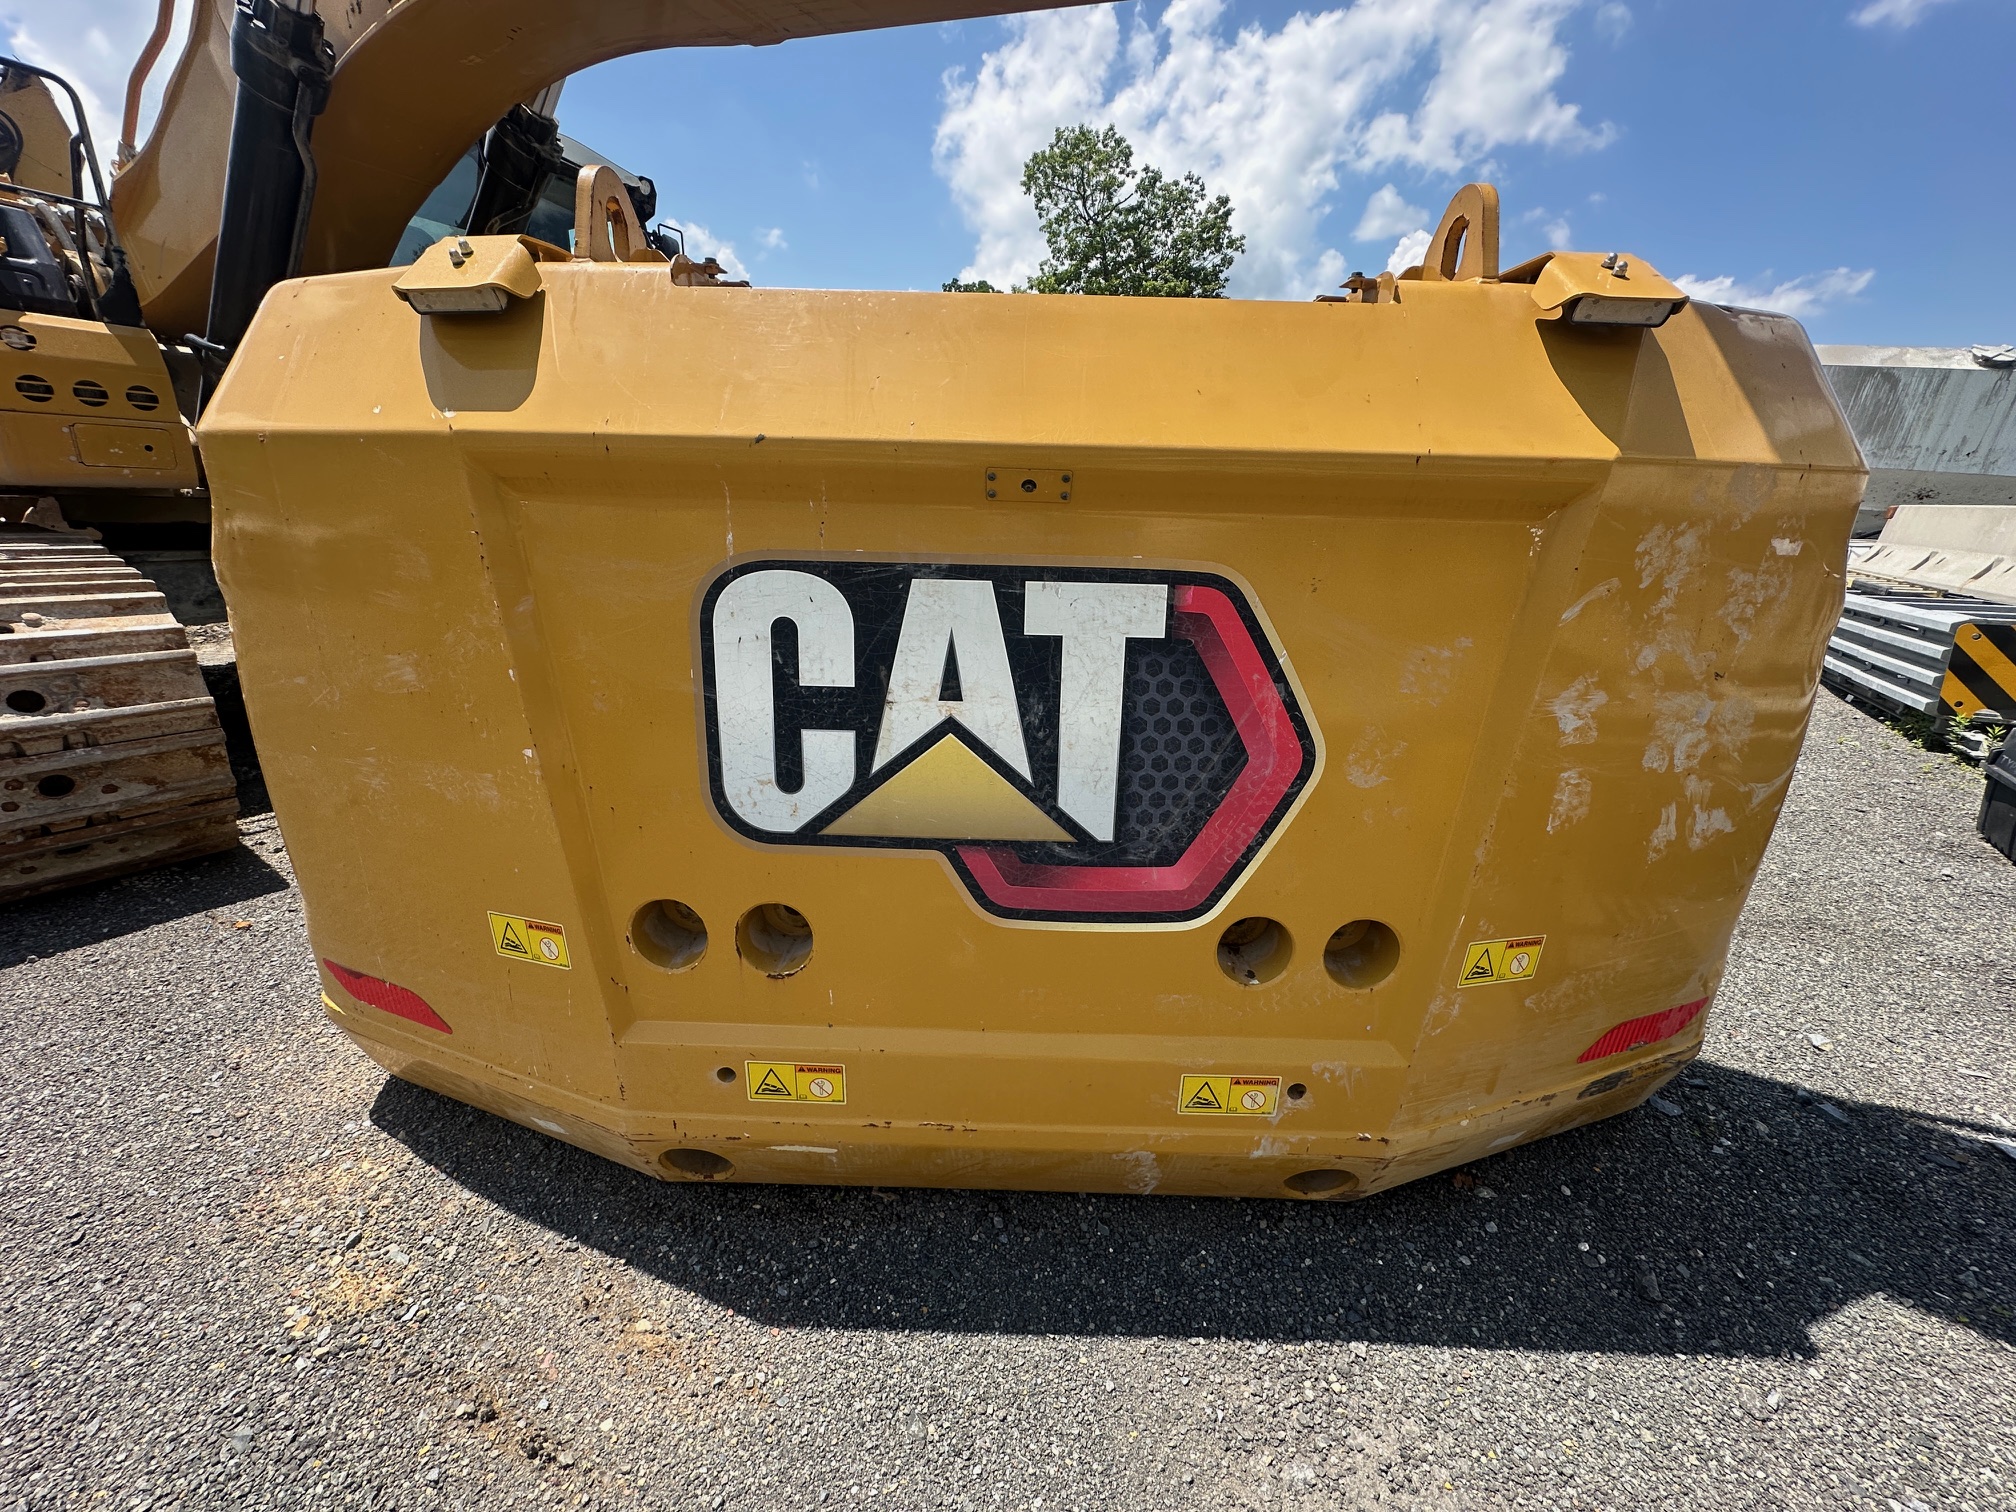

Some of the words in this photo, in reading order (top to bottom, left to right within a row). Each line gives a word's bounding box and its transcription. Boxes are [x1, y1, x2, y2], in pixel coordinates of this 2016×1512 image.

[713, 569, 1169, 842] CAT
[533, 924, 562, 935] WARNING
[1515, 939, 1542, 948] WARNING
[806, 1066, 842, 1074] WARNING
